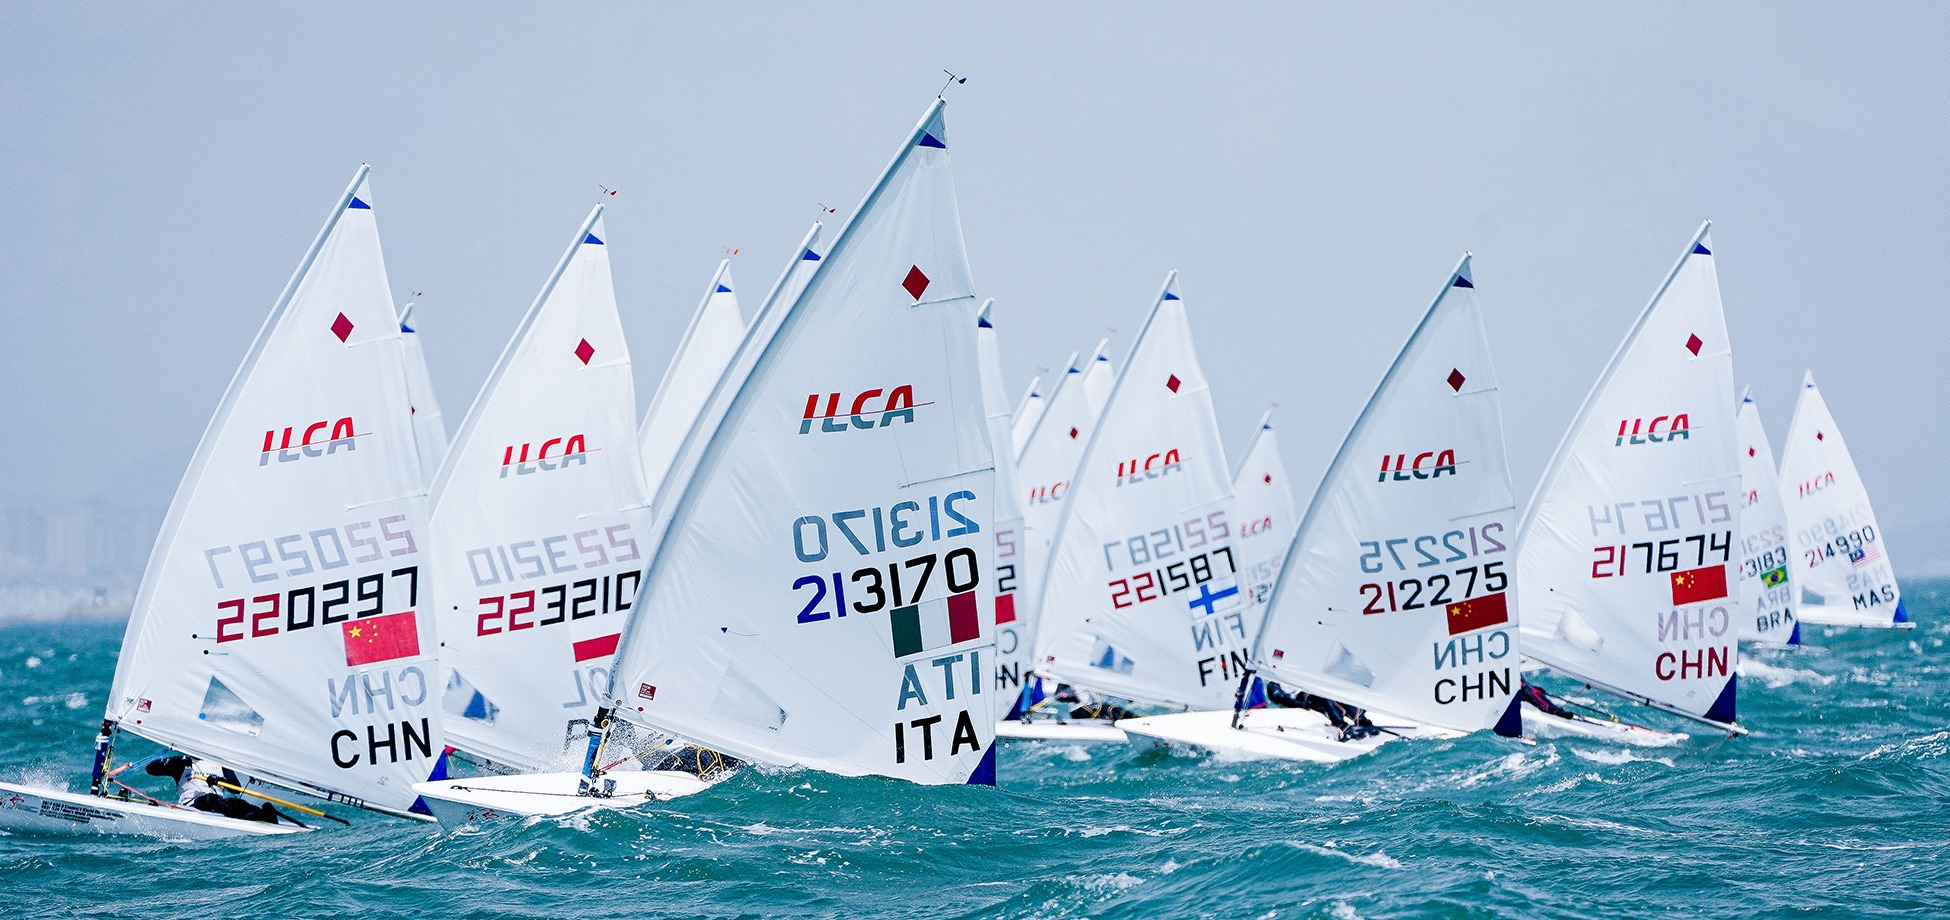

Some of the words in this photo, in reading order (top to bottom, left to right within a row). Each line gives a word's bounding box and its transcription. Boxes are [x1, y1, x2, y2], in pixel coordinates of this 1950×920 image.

[799, 384, 914, 434] ILCA
[1615, 414, 1689, 447] ILCA
[259, 417, 356, 466] ILCA
[500, 434, 587, 479] ILCA
[1116, 449, 1183, 487] ILCA
[1378, 449, 1456, 482] ILCA
[1800, 471, 1835, 499] ILCA
[1592, 531, 1731, 578] 217674
[1805, 525, 1875, 568] 214990
[792, 547, 980, 624] 213170
[1109, 546, 1236, 609] 221587
[1359, 561, 1508, 615] 212275
[1852, 584, 1895, 611] MAS
[217, 566, 418, 643] 220297
[477, 570, 641, 637] 223210
[1757, 607, 1793, 633] BRA
[1198, 648, 1249, 687] FIN
[1434, 667, 1511, 704] CHN
[1655, 646, 1729, 681] CHN
[330, 718, 432, 769] CHN
[895, 709, 981, 764] ITA
